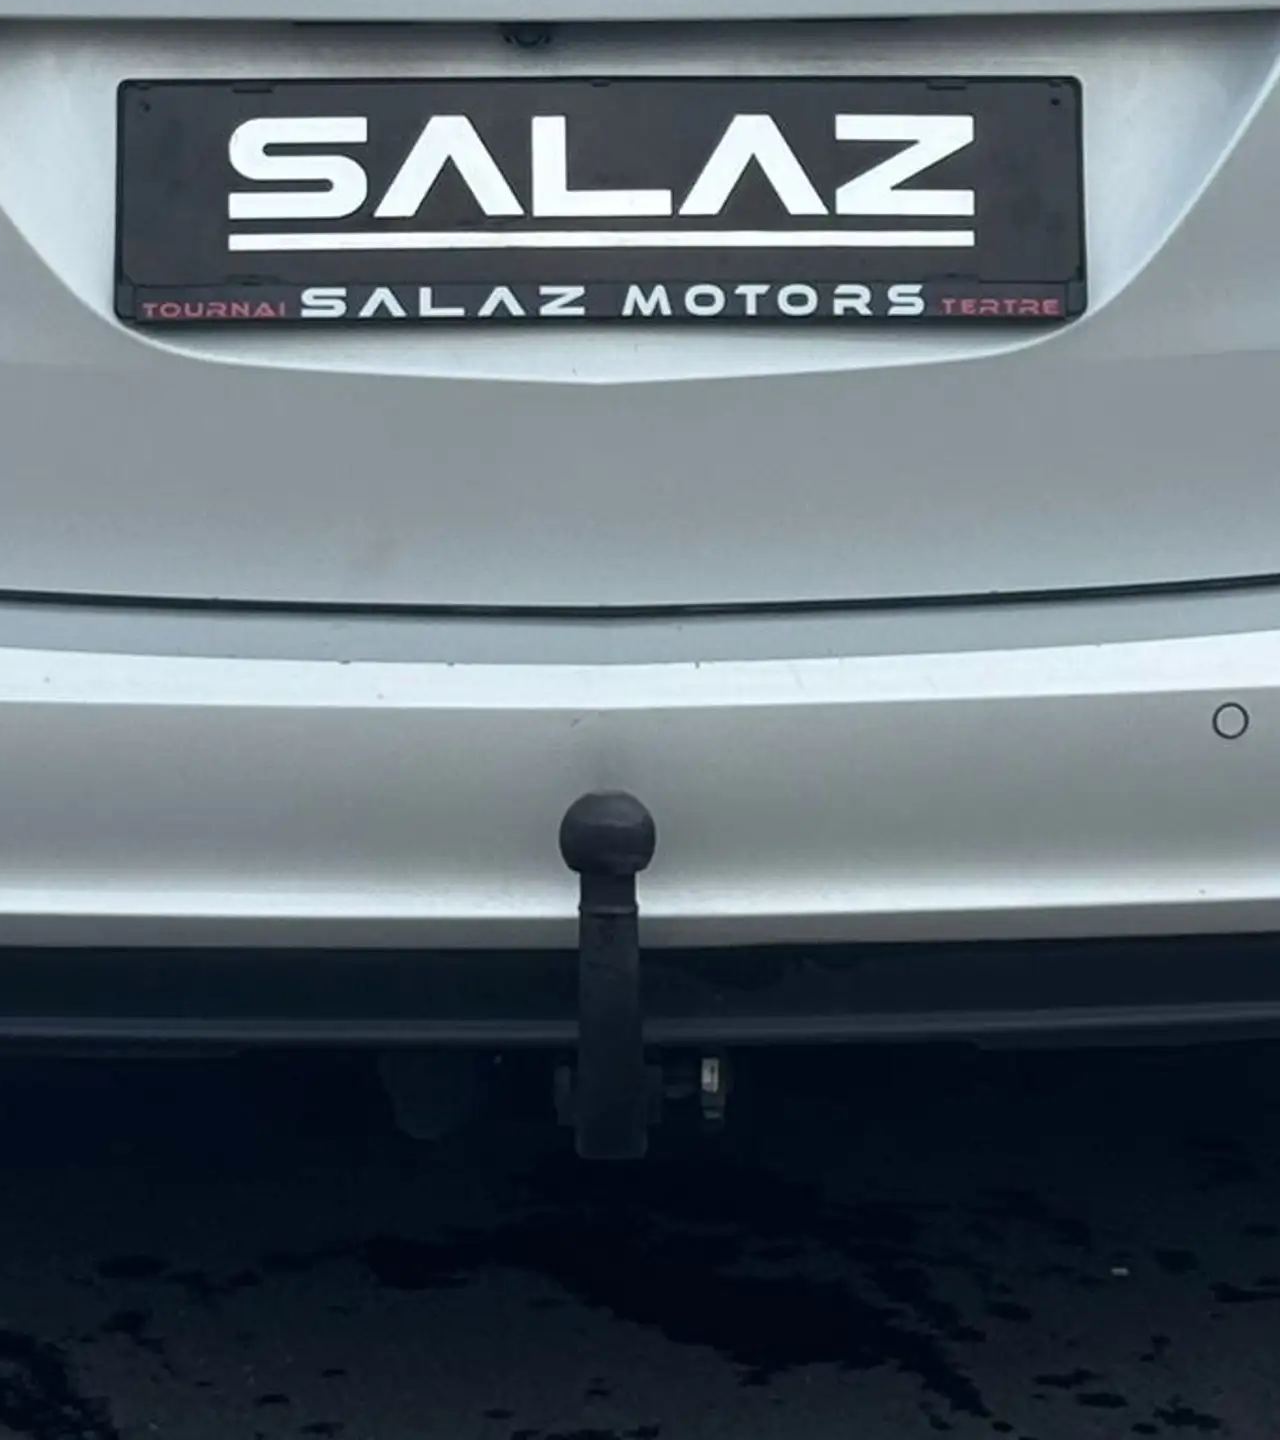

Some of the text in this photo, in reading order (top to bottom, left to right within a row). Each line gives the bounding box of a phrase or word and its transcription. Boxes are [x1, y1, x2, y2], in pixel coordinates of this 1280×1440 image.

[227, 113, 976, 219] SALAZ
[141, 283, 1061, 319] TOURNAI SALAZ MOTORS TERTRE
